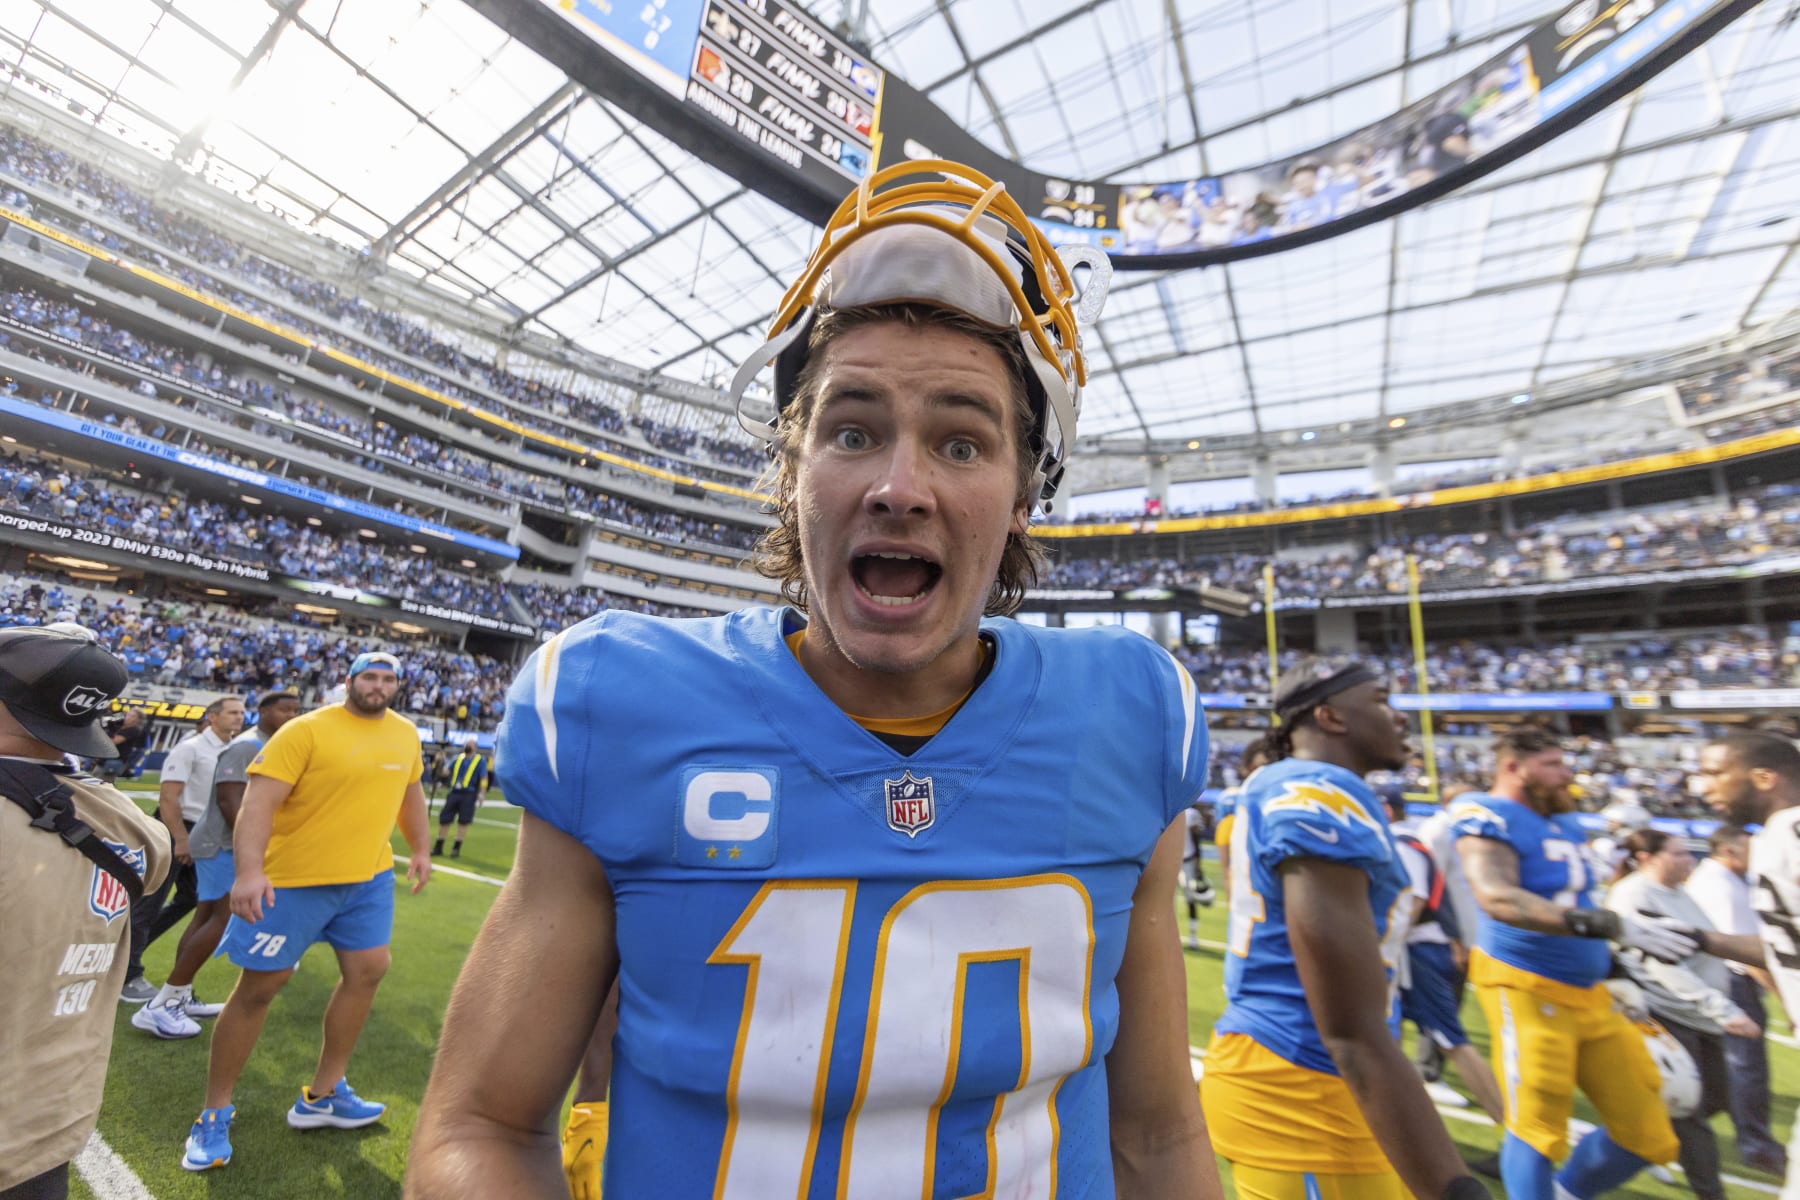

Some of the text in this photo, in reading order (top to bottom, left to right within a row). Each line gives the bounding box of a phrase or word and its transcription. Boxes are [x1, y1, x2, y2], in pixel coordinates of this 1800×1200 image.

[773, 10, 827, 57] FINAL
[766, 51, 821, 98] FINAL
[758, 95, 815, 141] FINAL
[72, 528, 112, 546] 2023
[112, 537, 151, 555] BMW
[151, 545, 184, 562] 530e
[683, 772, 772, 841] C
[893, 799, 929, 826] NFL
[247, 931, 288, 957] 78
[53, 979, 97, 1017] 130
[706, 873, 1096, 1200] 10
